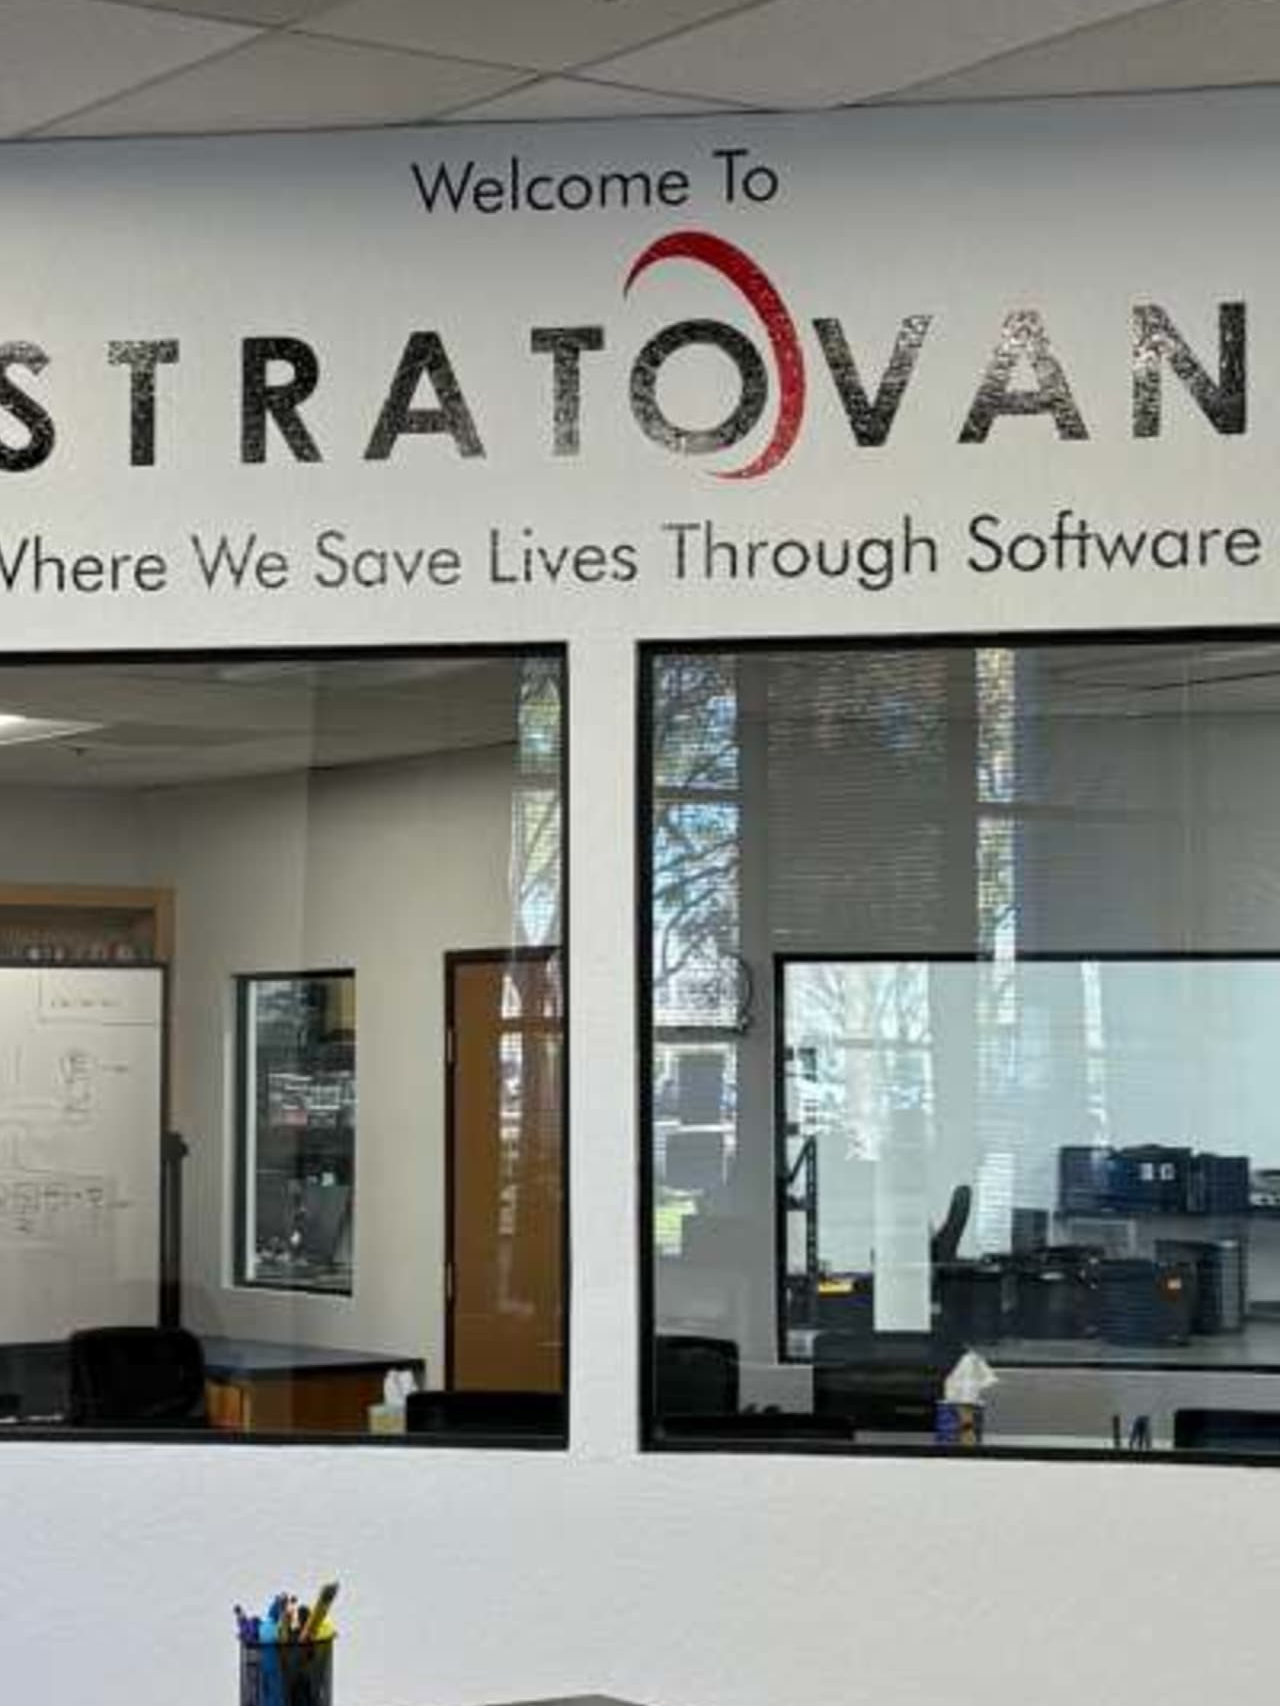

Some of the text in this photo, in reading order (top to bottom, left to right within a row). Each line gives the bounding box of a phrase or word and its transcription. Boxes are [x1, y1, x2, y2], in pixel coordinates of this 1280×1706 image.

[410, 147, 780, 214] Welcome To
[190, 532, 291, 592] We
[314, 528, 462, 589] Save
[489, 525, 639, 586] Lives
[661, 517, 939, 593] Through
[967, 508, 1263, 575] Software
